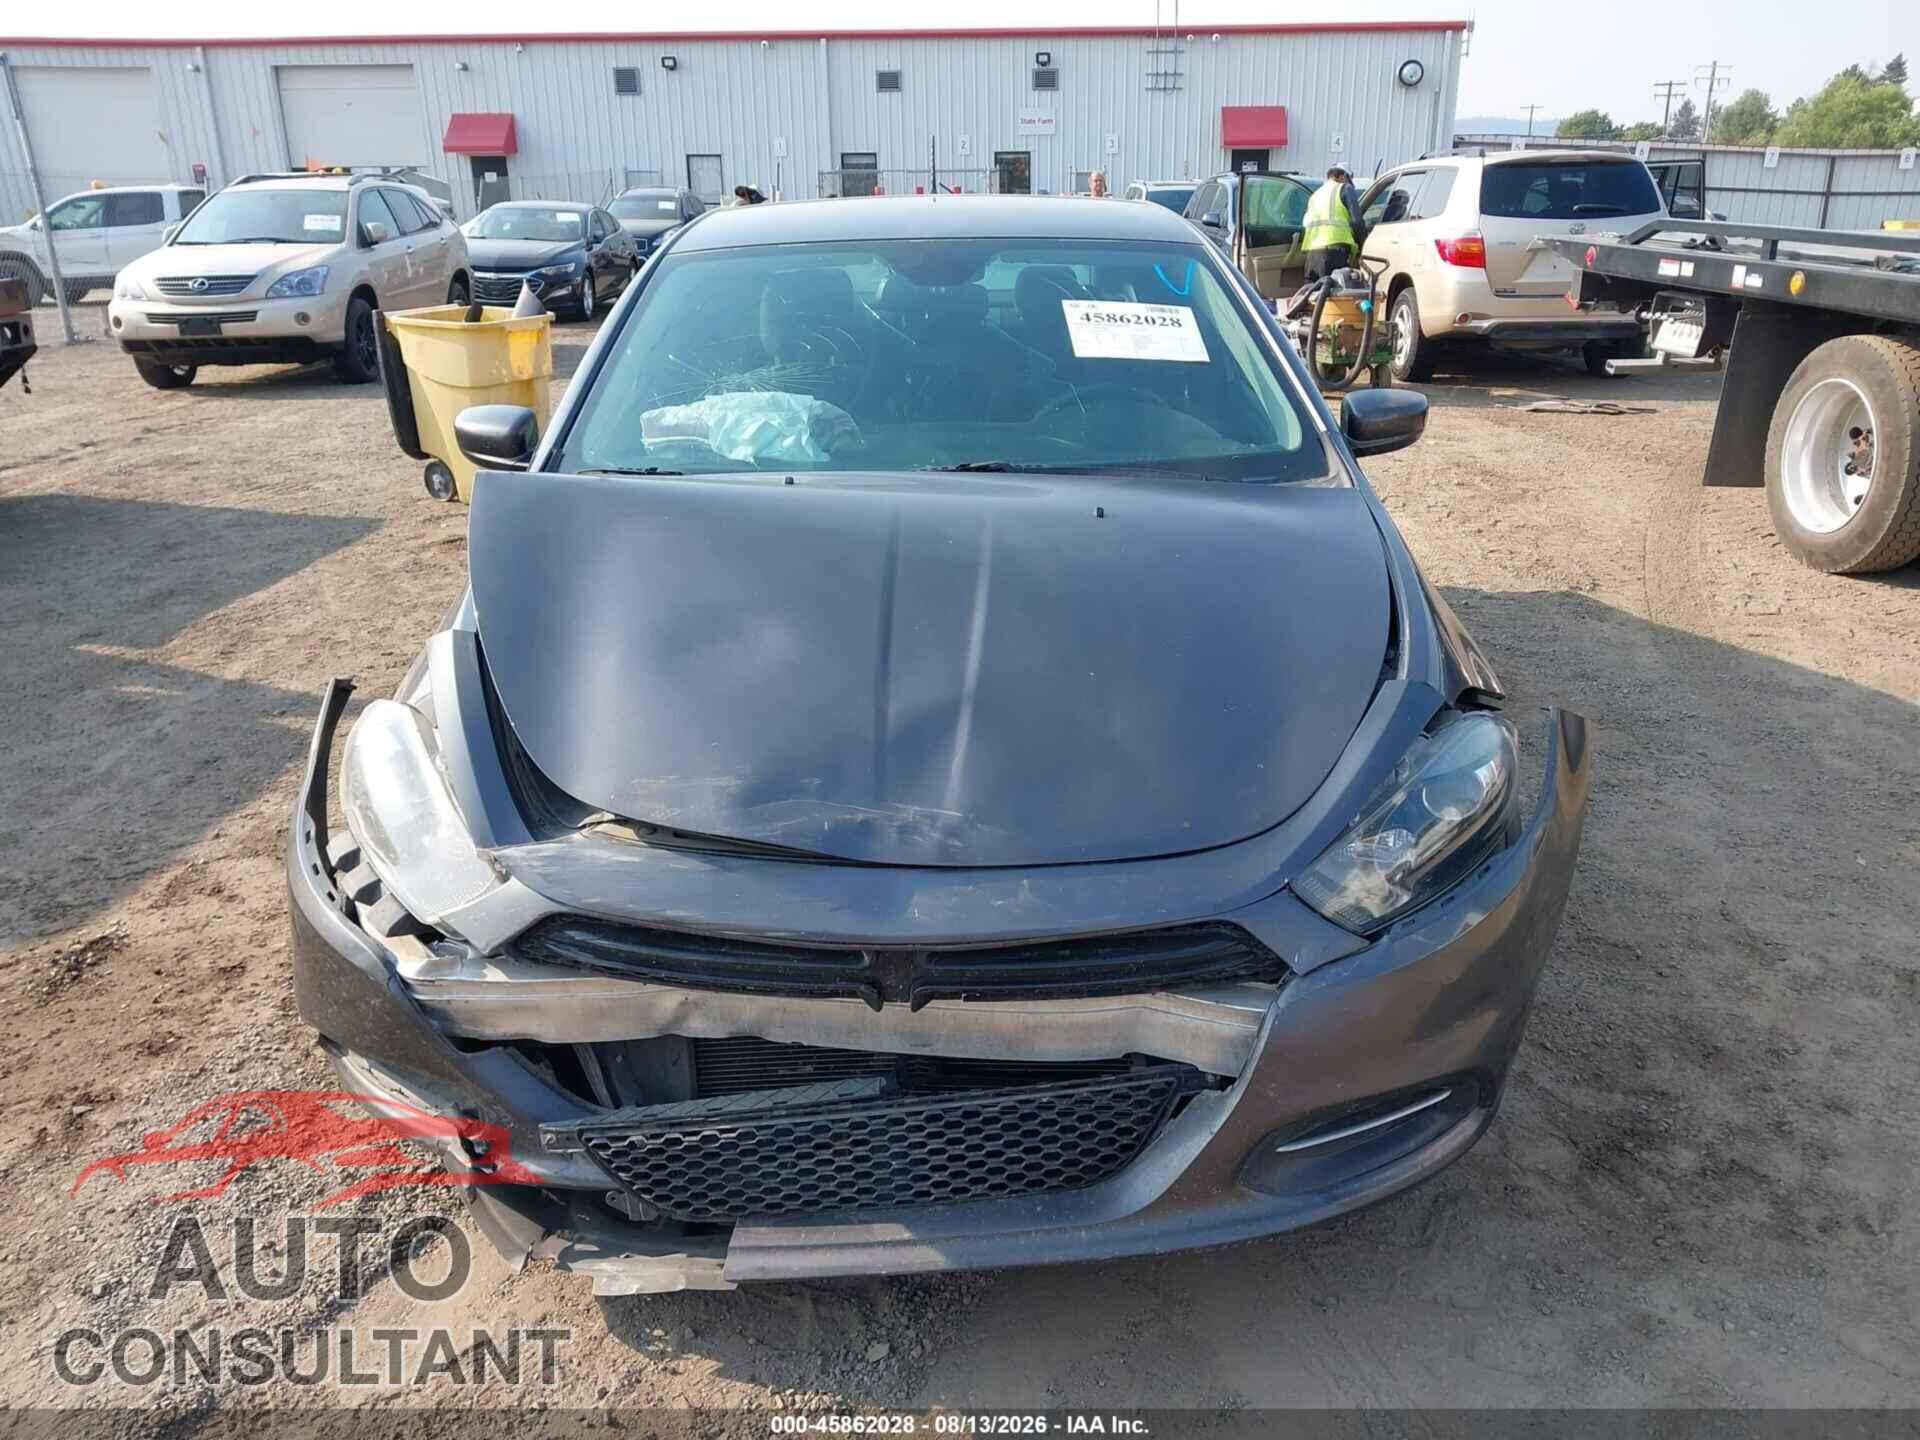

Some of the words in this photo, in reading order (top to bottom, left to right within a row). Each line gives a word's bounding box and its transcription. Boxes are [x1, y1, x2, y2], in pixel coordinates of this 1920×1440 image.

[1020, 117, 1036, 125] State
[1037, 117, 1054, 125] Farm
[1080, 311, 1183, 328] 45862028
